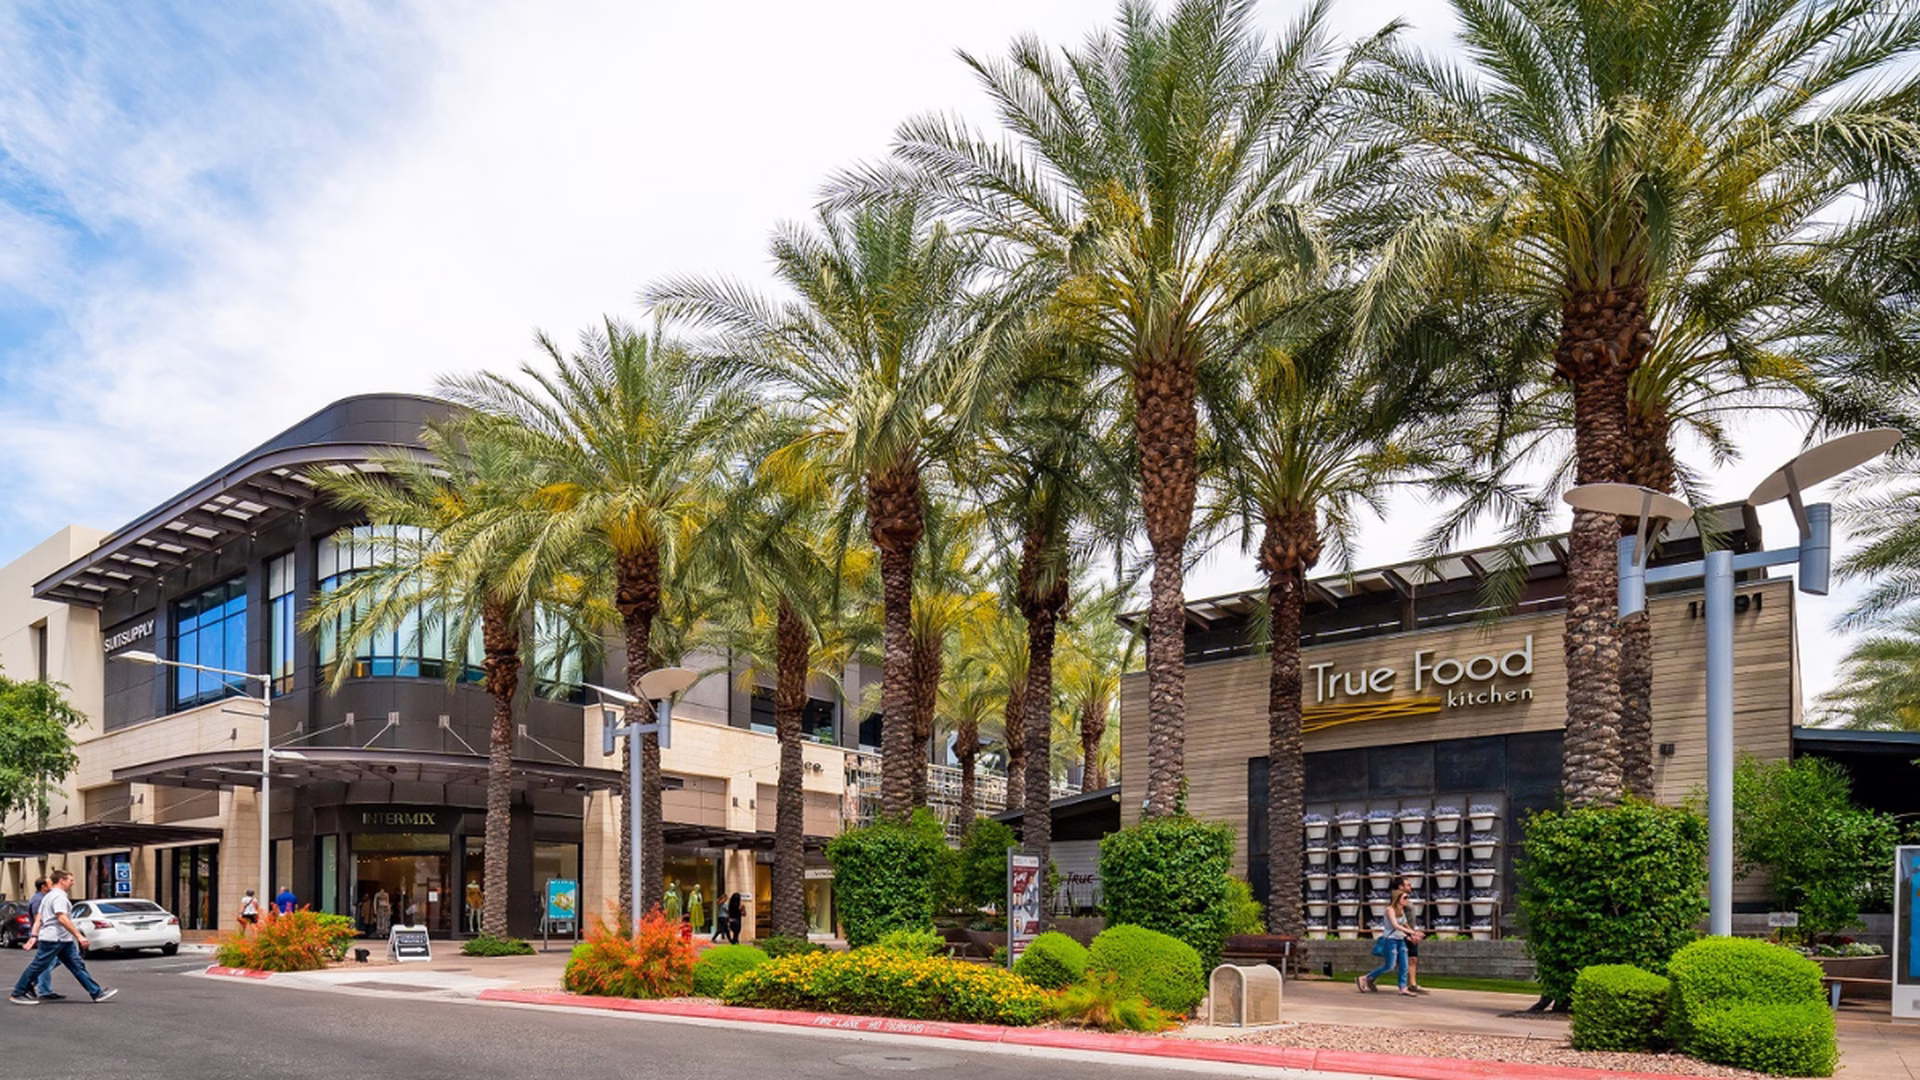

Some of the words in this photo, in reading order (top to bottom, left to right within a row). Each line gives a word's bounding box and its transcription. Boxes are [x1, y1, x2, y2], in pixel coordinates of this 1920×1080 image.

[104, 619, 154, 653] SUITSUPPLY
[1308, 662, 1396, 702] True
[1415, 634, 1533, 692] Food
[1448, 684, 1533, 708] kitchen
[362, 812, 436, 825] INTERMIX
[813, 1015, 835, 1026] FIRE
[836, 1018, 860, 1029] LANE
